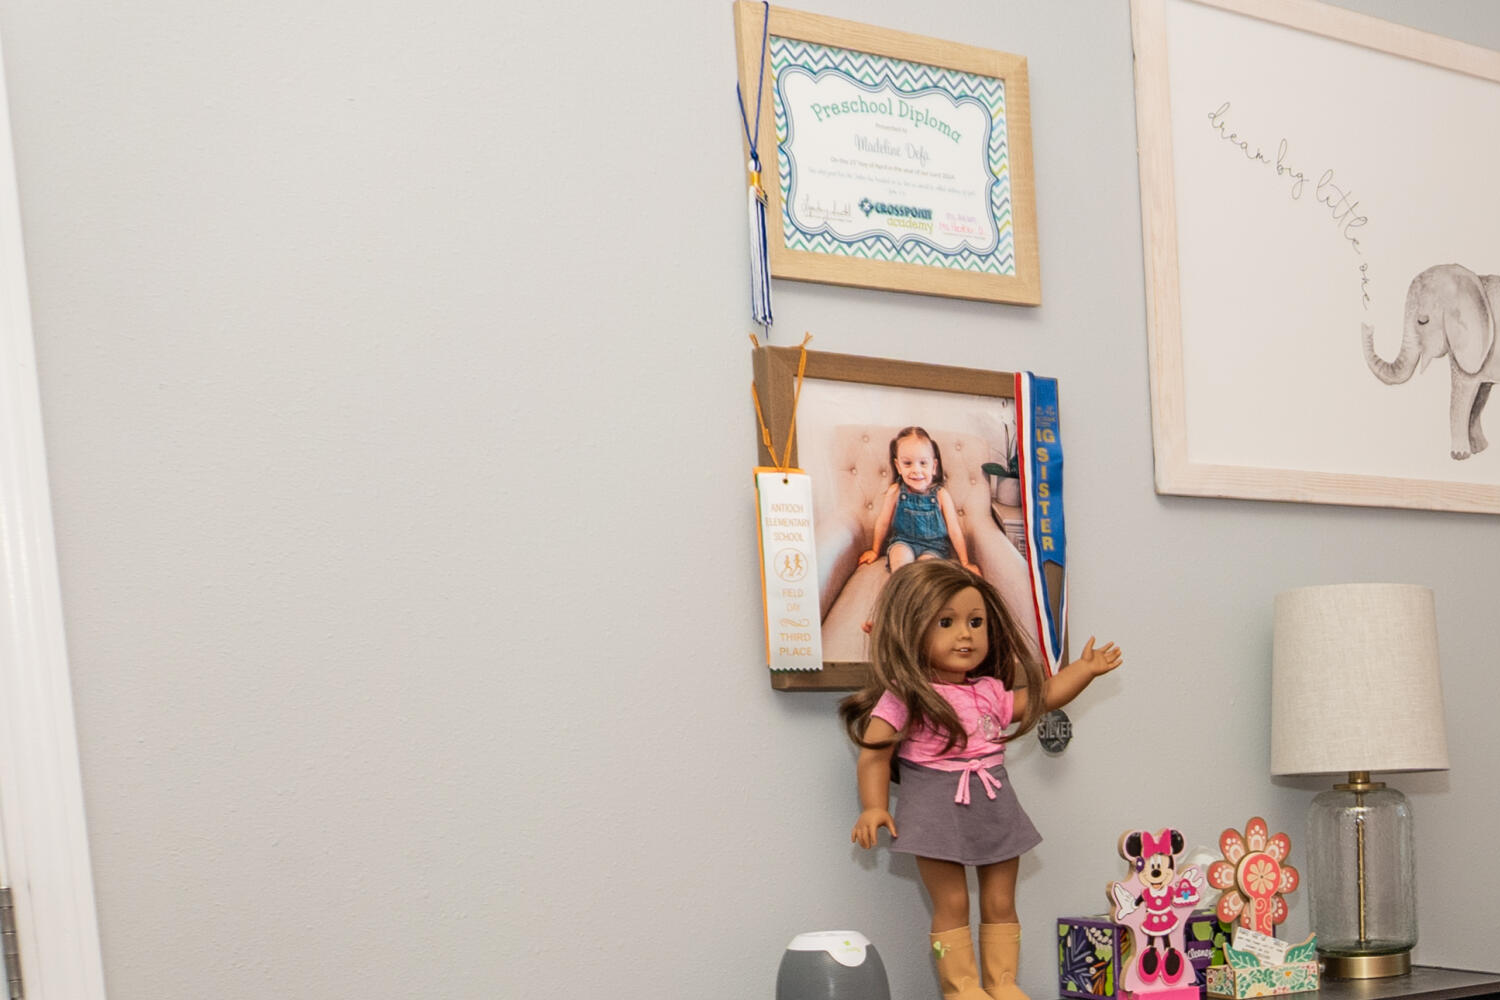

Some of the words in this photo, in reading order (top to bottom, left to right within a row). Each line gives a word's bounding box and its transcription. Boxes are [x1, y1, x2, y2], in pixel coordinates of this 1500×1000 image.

[810, 95, 893, 122] Preschool
[898, 100, 961, 144] Diploma
[1208, 102, 1271, 165] dream
[1276, 138, 1310, 200] big
[1316, 169, 1368, 254] little
[1359, 263, 1370, 311] one
[887, 217, 934, 234] academy
[1035, 427, 1056, 443] IG
[1036, 447, 1055, 552] SISTER
[771, 503, 804, 513] ANTIOCH
[765, 518, 810, 527] ELEMENTARY
[773, 531, 805, 542] SCHOOL
[782, 589, 803, 598] FIELD
[779, 632, 811, 642] THIRD
[779, 647, 812, 656] PLACE
[1037, 721, 1073, 738] SILVER
